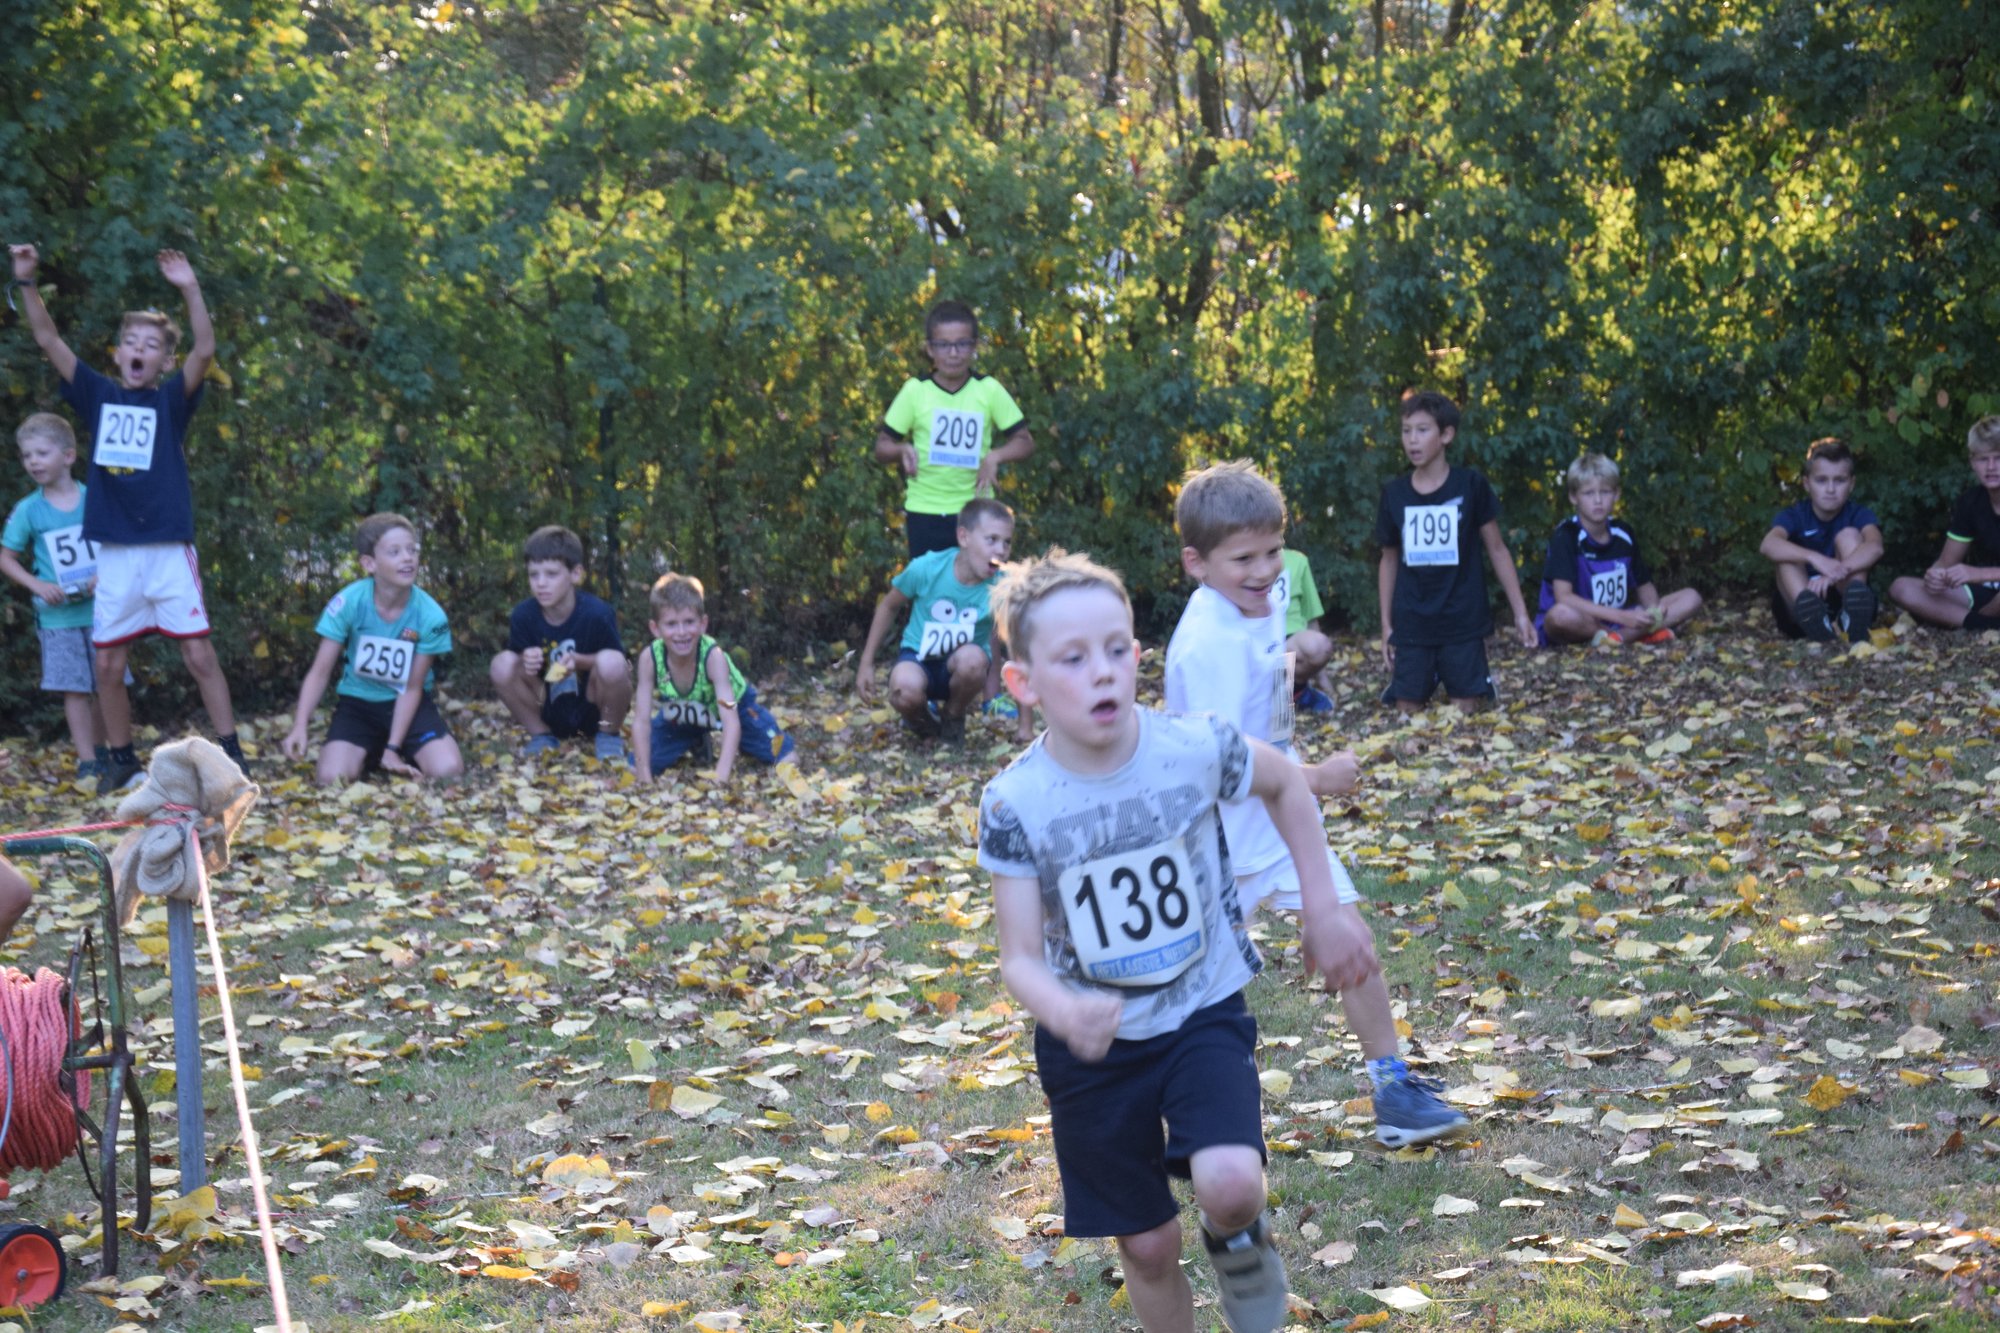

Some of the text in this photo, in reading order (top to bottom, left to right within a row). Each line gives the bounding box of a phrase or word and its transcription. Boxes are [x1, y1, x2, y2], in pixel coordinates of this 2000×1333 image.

[104, 412, 152, 448] 205
[934, 414, 978, 450] 209
[1409, 512, 1451, 546] 199
[1595, 575, 1625, 606] 295
[359, 643, 407, 679] 259
[1074, 855, 1189, 950] 138
